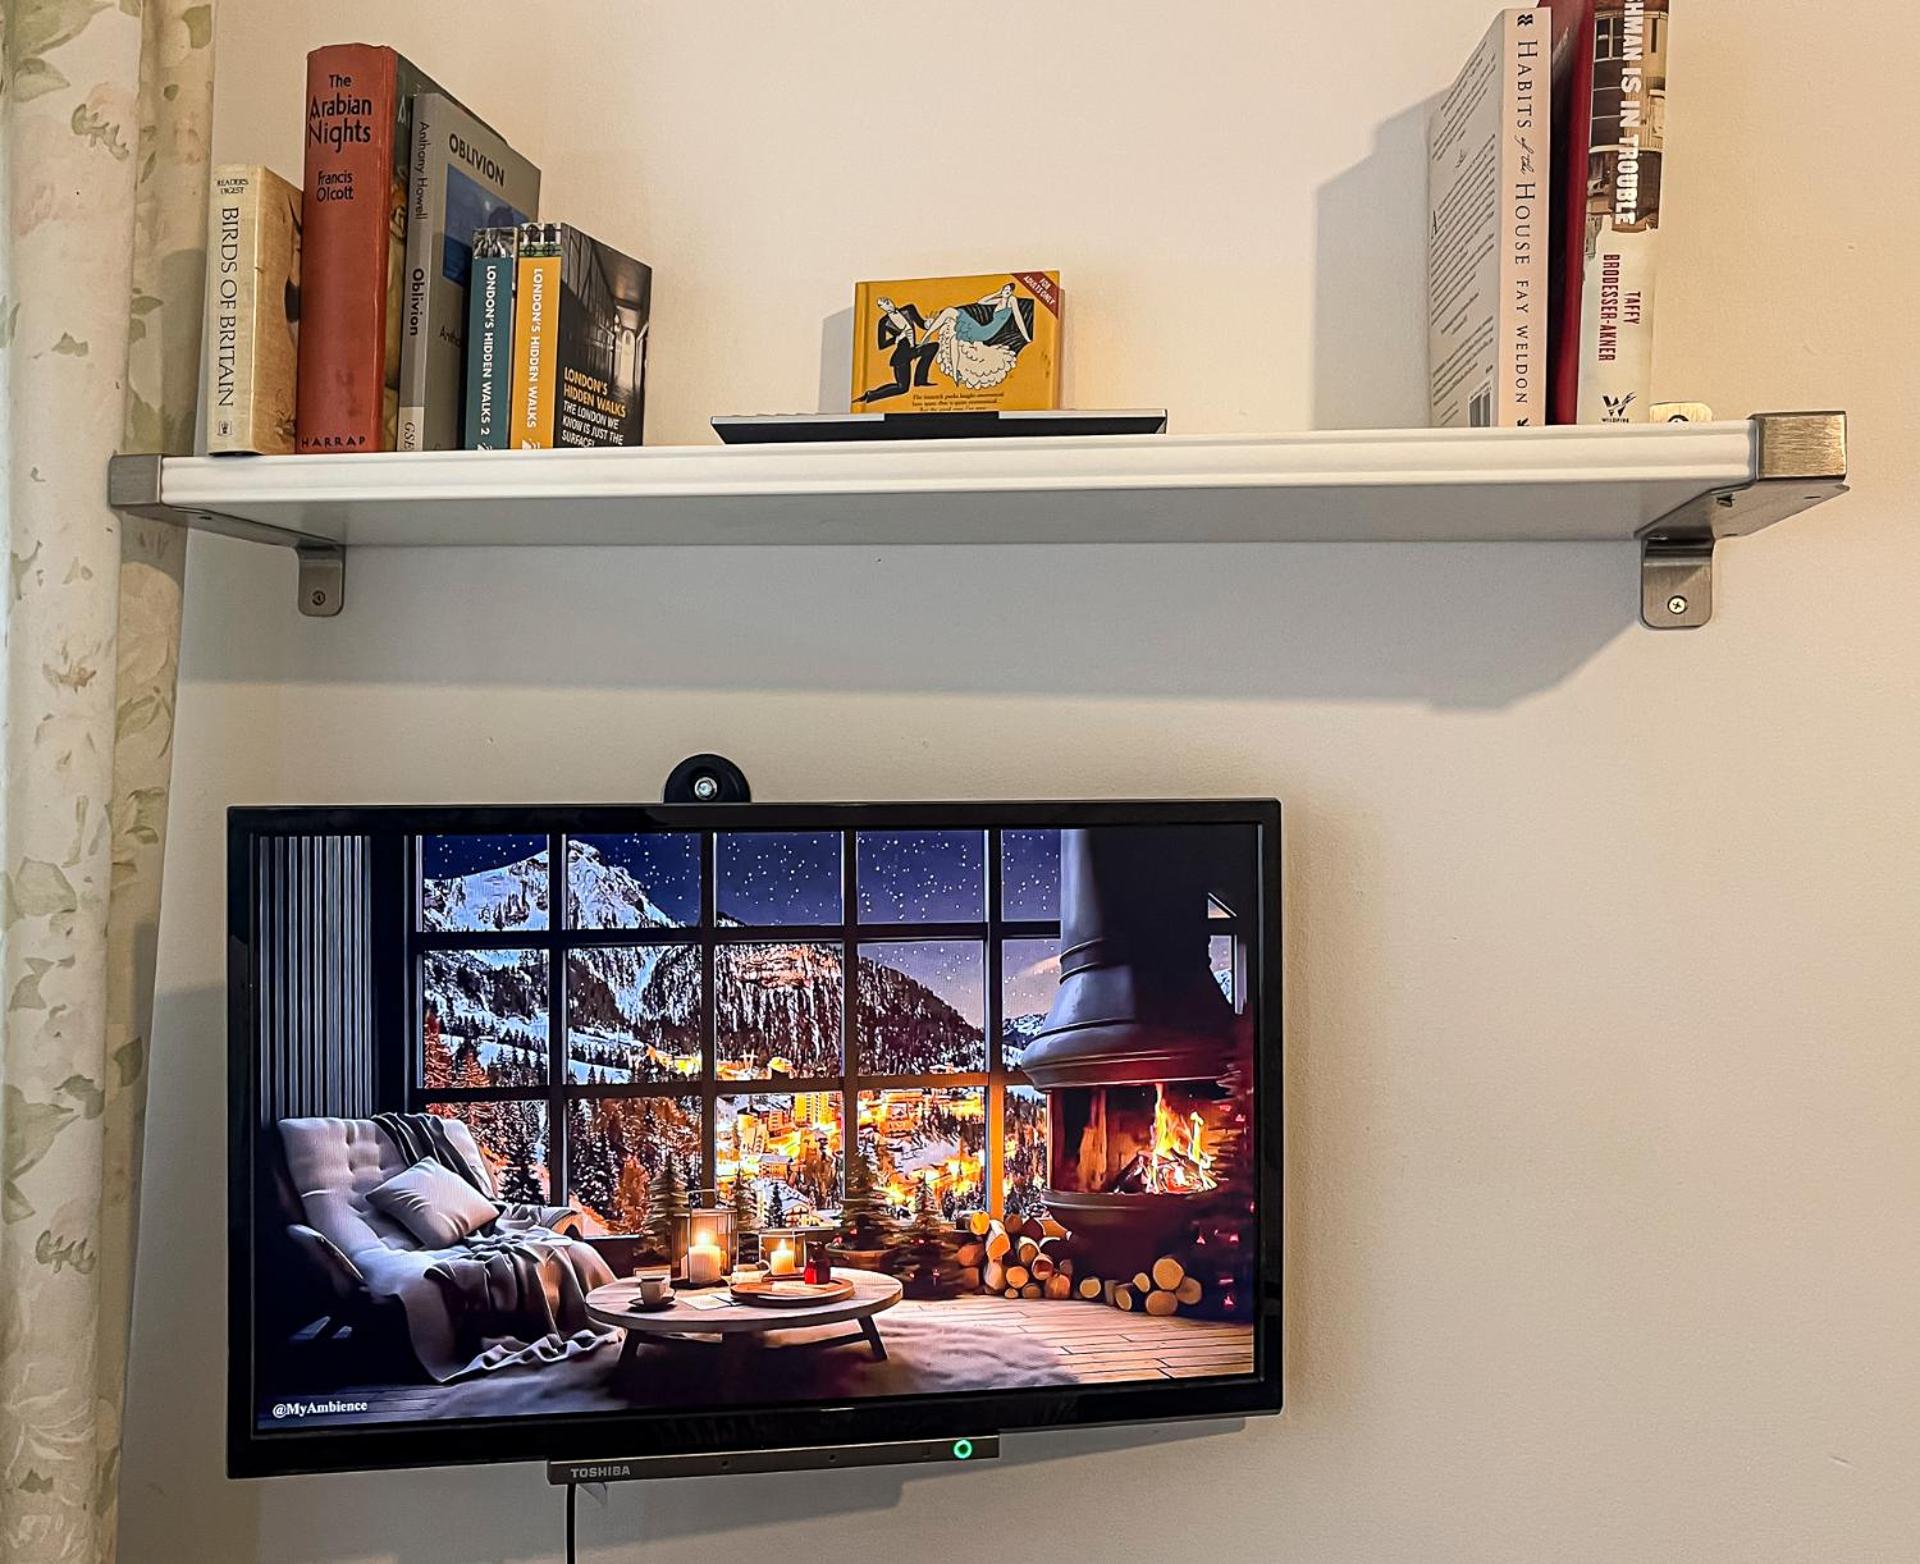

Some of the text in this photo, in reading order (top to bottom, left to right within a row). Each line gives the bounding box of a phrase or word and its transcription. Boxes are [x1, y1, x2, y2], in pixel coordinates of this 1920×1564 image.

[329, 74, 352, 88] The
[310, 93, 372, 120] Arabian
[1615, 0, 1644, 225] HMAN IS IN TROUBLE
[308, 118, 371, 153] Nights
[1514, 40, 1538, 264] HABITS of the HOUSE
[318, 170, 352, 186] Francis
[414, 122, 431, 220] Anthony Howell
[449, 133, 504, 188] OBLIVION
[316, 187, 354, 202] Olcott
[218, 207, 239, 406] BIRDS OF BRITAIN
[409, 268, 425, 336] Oblivion
[1598, 254, 1620, 361] BRODESSER-AKNER
[1623, 291, 1641, 325] TAFFY
[482, 332, 494, 378] HIDDEN
[528, 336, 540, 382] HIDDEN
[1516, 280, 1528, 403] FAY WELDON
[480, 382, 492, 424] WALKS
[526, 386, 538, 429] WALKS
[563, 383, 626, 418] HIDDEN WALKS
[563, 400, 620, 430] THE LONDON WE
[301, 435, 367, 449] HARRAP
[480, 427, 490, 436] 2
[562, 415, 624, 446] KNOW IS JUST THE
[272, 1400, 368, 1419] @MyAmbience
[570, 1465, 631, 1479] TOSHIBA
